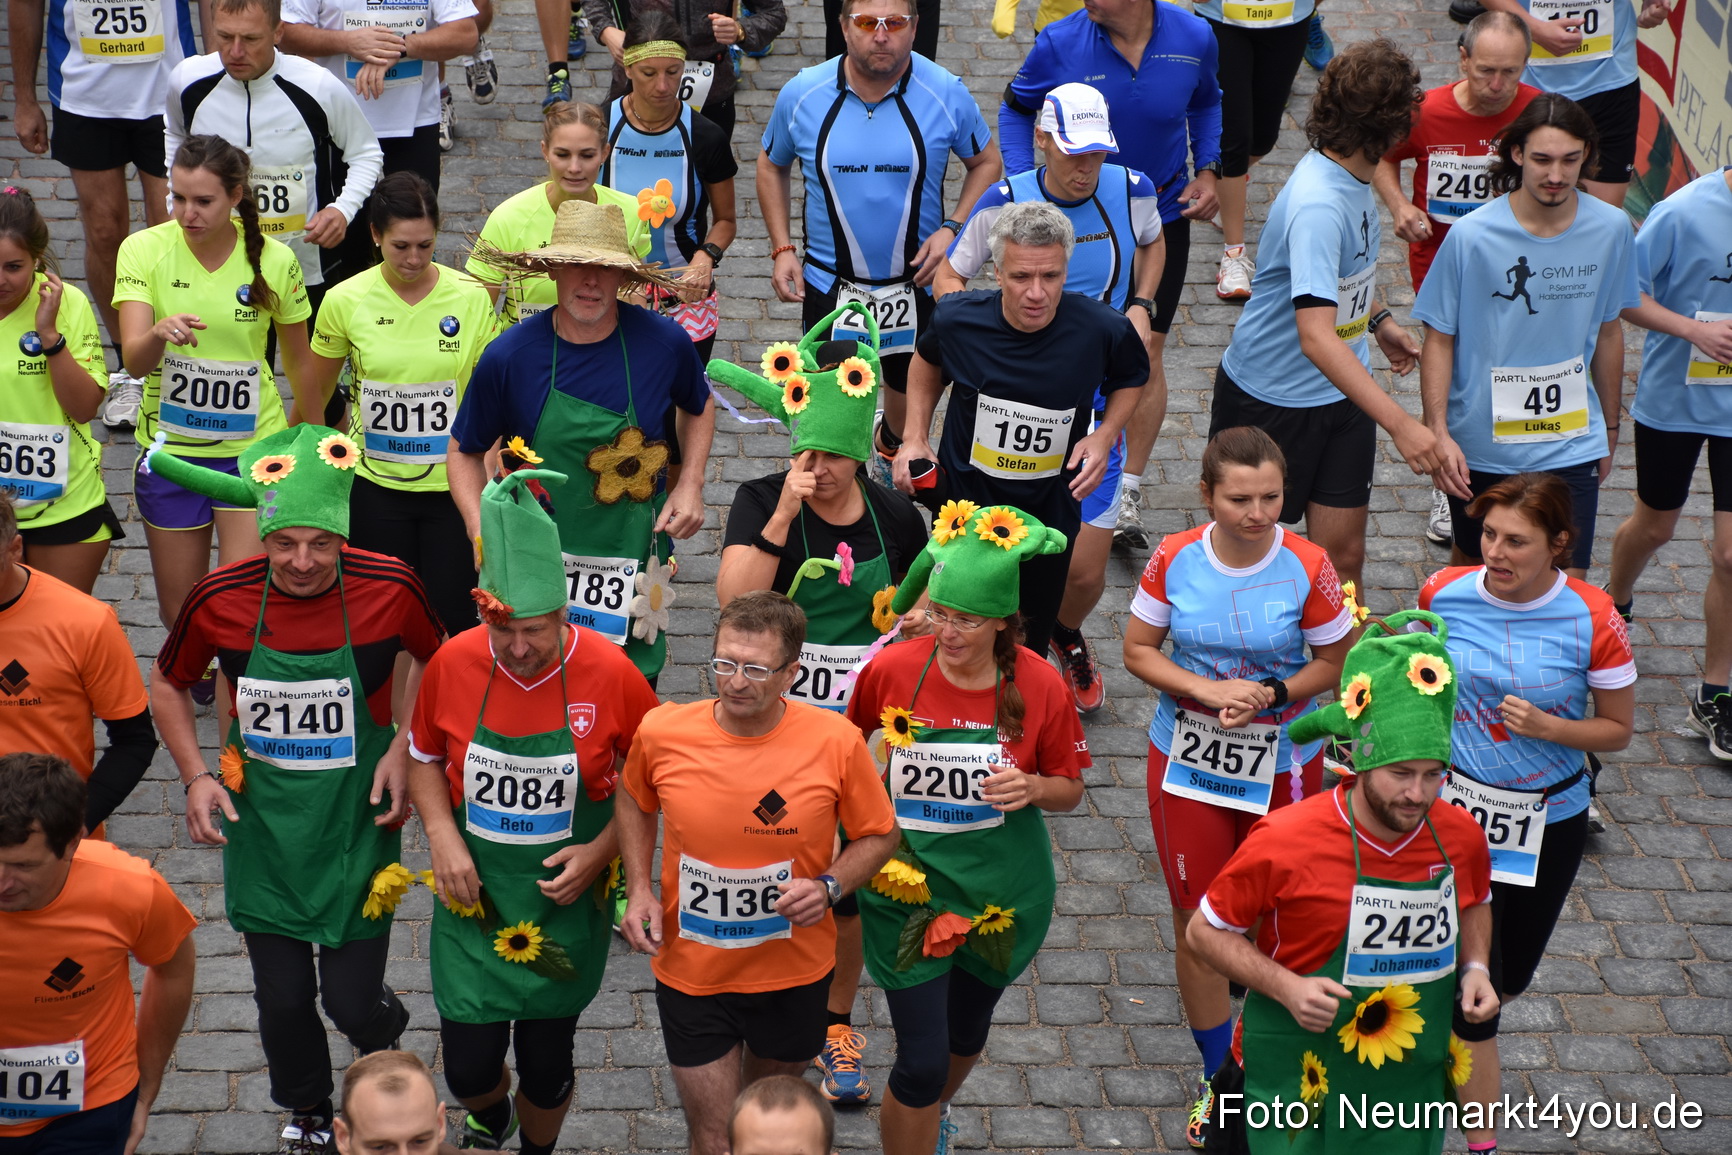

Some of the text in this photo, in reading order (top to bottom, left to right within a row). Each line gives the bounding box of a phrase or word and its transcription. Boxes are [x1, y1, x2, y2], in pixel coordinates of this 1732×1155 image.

[92, 6, 147, 34] 255
[1246, 8, 1273, 20] Tanja
[100, 41, 145, 53] Gerhard
[1071, 112, 1105, 121] ERDINGER
[1431, 161, 1459, 170] PARTL
[1541, 264, 1598, 279] GYM HIP
[1539, 291, 1595, 300] Halbmarathon
[1549, 283, 1587, 292] P-Seminar
[1350, 286, 1369, 319] 14
[235, 309, 258, 317] Partl
[439, 340, 460, 348] Partl
[18, 360, 47, 370] Partl
[164, 358, 244, 376] PARTL Neumarkt
[1494, 369, 1571, 383] PARTL Neumarkt
[170, 373, 250, 410] 2006
[363, 388, 439, 398] PARTL Neumarkt
[1524, 384, 1561, 415] 49
[186, 414, 227, 428] Carina
[370, 401, 448, 433] 2013
[979, 402, 1058, 425] PARTL Neumarkt
[1, 430, 48, 441] Neumarkt
[995, 421, 1053, 454] 195
[388, 439, 430, 452] Nadine
[996, 456, 1036, 470] Stefan
[573, 561, 619, 572] Neumarkt
[566, 570, 624, 610] 183
[567, 610, 596, 627] rank
[240, 687, 332, 699] PARTL Neumarkt
[250, 702, 344, 735] 2140
[952, 719, 964, 728] 11.
[1212, 726, 1260, 741] Neumarkt
[263, 741, 332, 759] Wolfgang
[895, 747, 982, 763] PARTL Neumarkt
[1181, 731, 1268, 777] 2457
[468, 753, 558, 775] PARTL Neumarkt
[475, 771, 566, 811] 2084
[902, 765, 991, 801] 2203
[1190, 772, 1246, 797] Susanne
[1478, 793, 1529, 811] Neumarkt
[923, 804, 973, 823] Brigitte
[501, 817, 534, 832] Reto
[743, 827, 798, 836] FliesenEichl
[681, 863, 772, 884] PARTL Neumarkt
[1177, 853, 1187, 880] FUSION
[690, 881, 782, 917] 2136
[1356, 896, 1396, 909] PARTL
[714, 925, 754, 936] Franz
[1362, 906, 1451, 949] 2423
[1370, 957, 1440, 973] Johannes
[34, 985, 96, 1004] FliesenEichl
[0, 1056, 60, 1067] Neumarkt
